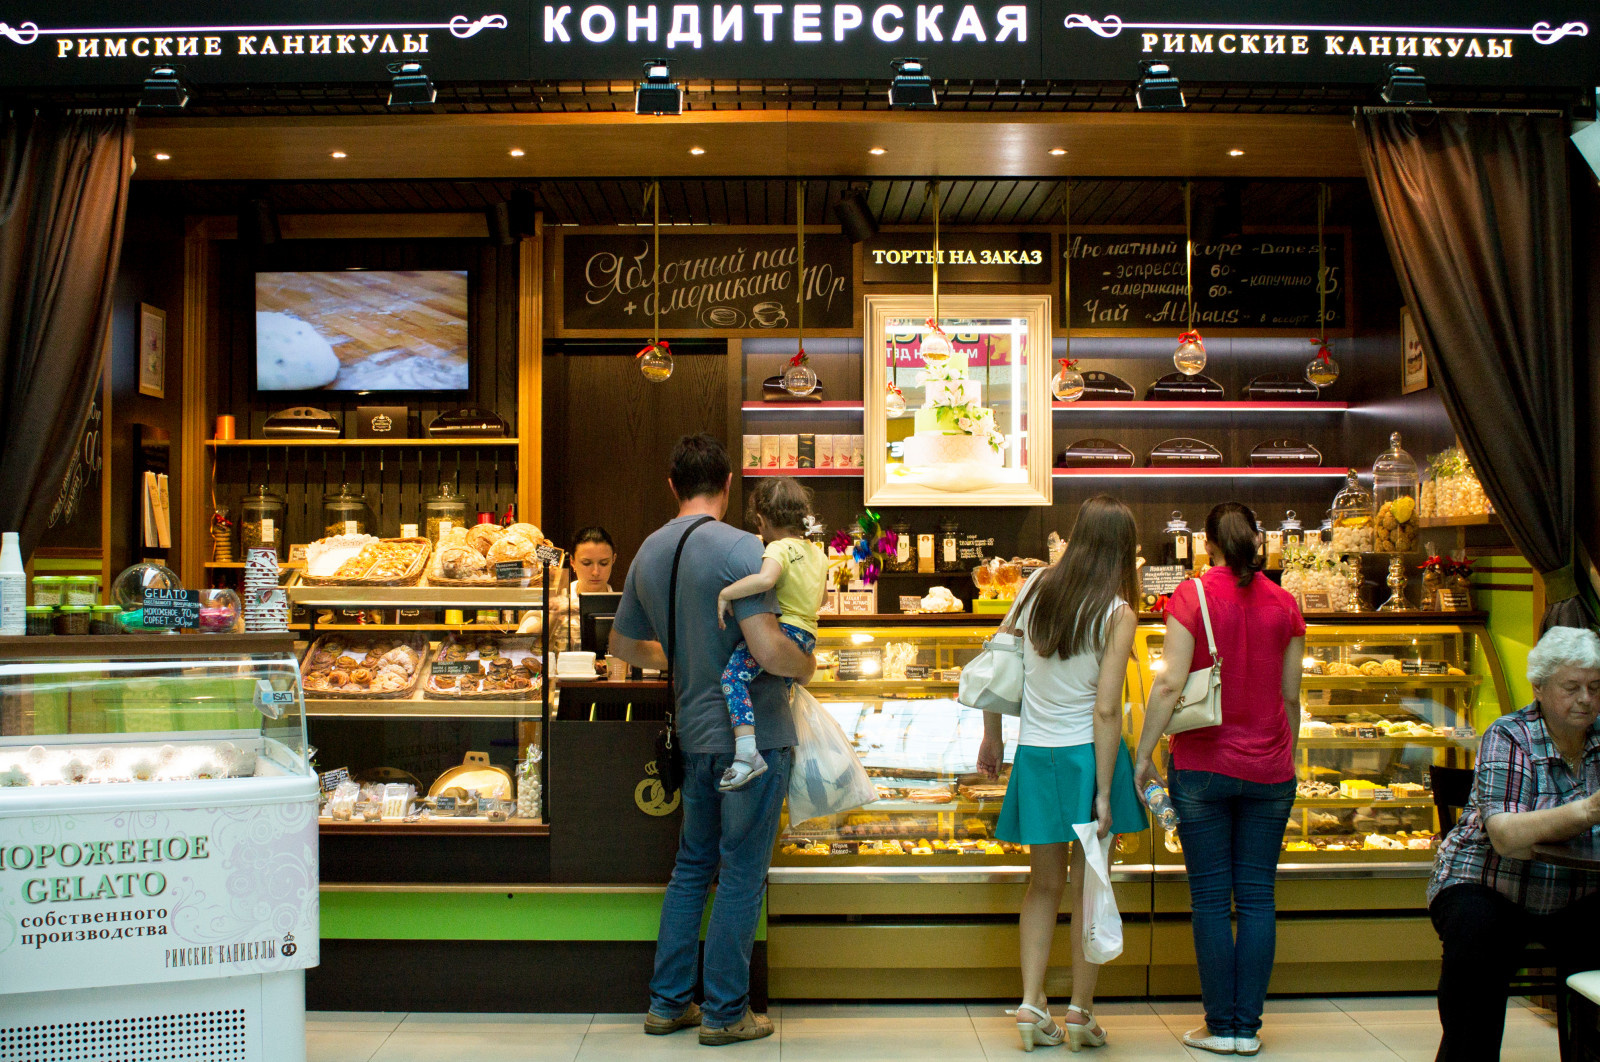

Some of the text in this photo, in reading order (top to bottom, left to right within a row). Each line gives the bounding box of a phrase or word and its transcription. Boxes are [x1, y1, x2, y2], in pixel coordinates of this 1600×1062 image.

[543, 5, 1029, 49] КОНДИТЕРСКАЯ
[57, 33, 430, 58] РИМСКИЕ КАНИКУЛЫ
[1141, 33, 1514, 58] РИМСКИЕ КАНИКУЛЫ
[872, 249, 1043, 265] ТОРТЫ НА ЗАКАЗ
[1062, 235, 1178, 259] Ароматный
[585, 239, 747, 305] Яблочный
[1082, 299, 1130, 323] Чай
[144, 588, 188, 600] GELATO
[143, 615, 169, 625] СОРБЕТ
[144, 607, 178, 617] МОРОЖЕНОЕ
[0, 835, 210, 871] ОРОЖЕНОЕ
[21, 871, 168, 904] GELATO
[21, 907, 168, 928] собственного
[21, 924, 168, 950] производства
[165, 939, 277, 968] РИМСКИЕ КАНИКУЛЫ
